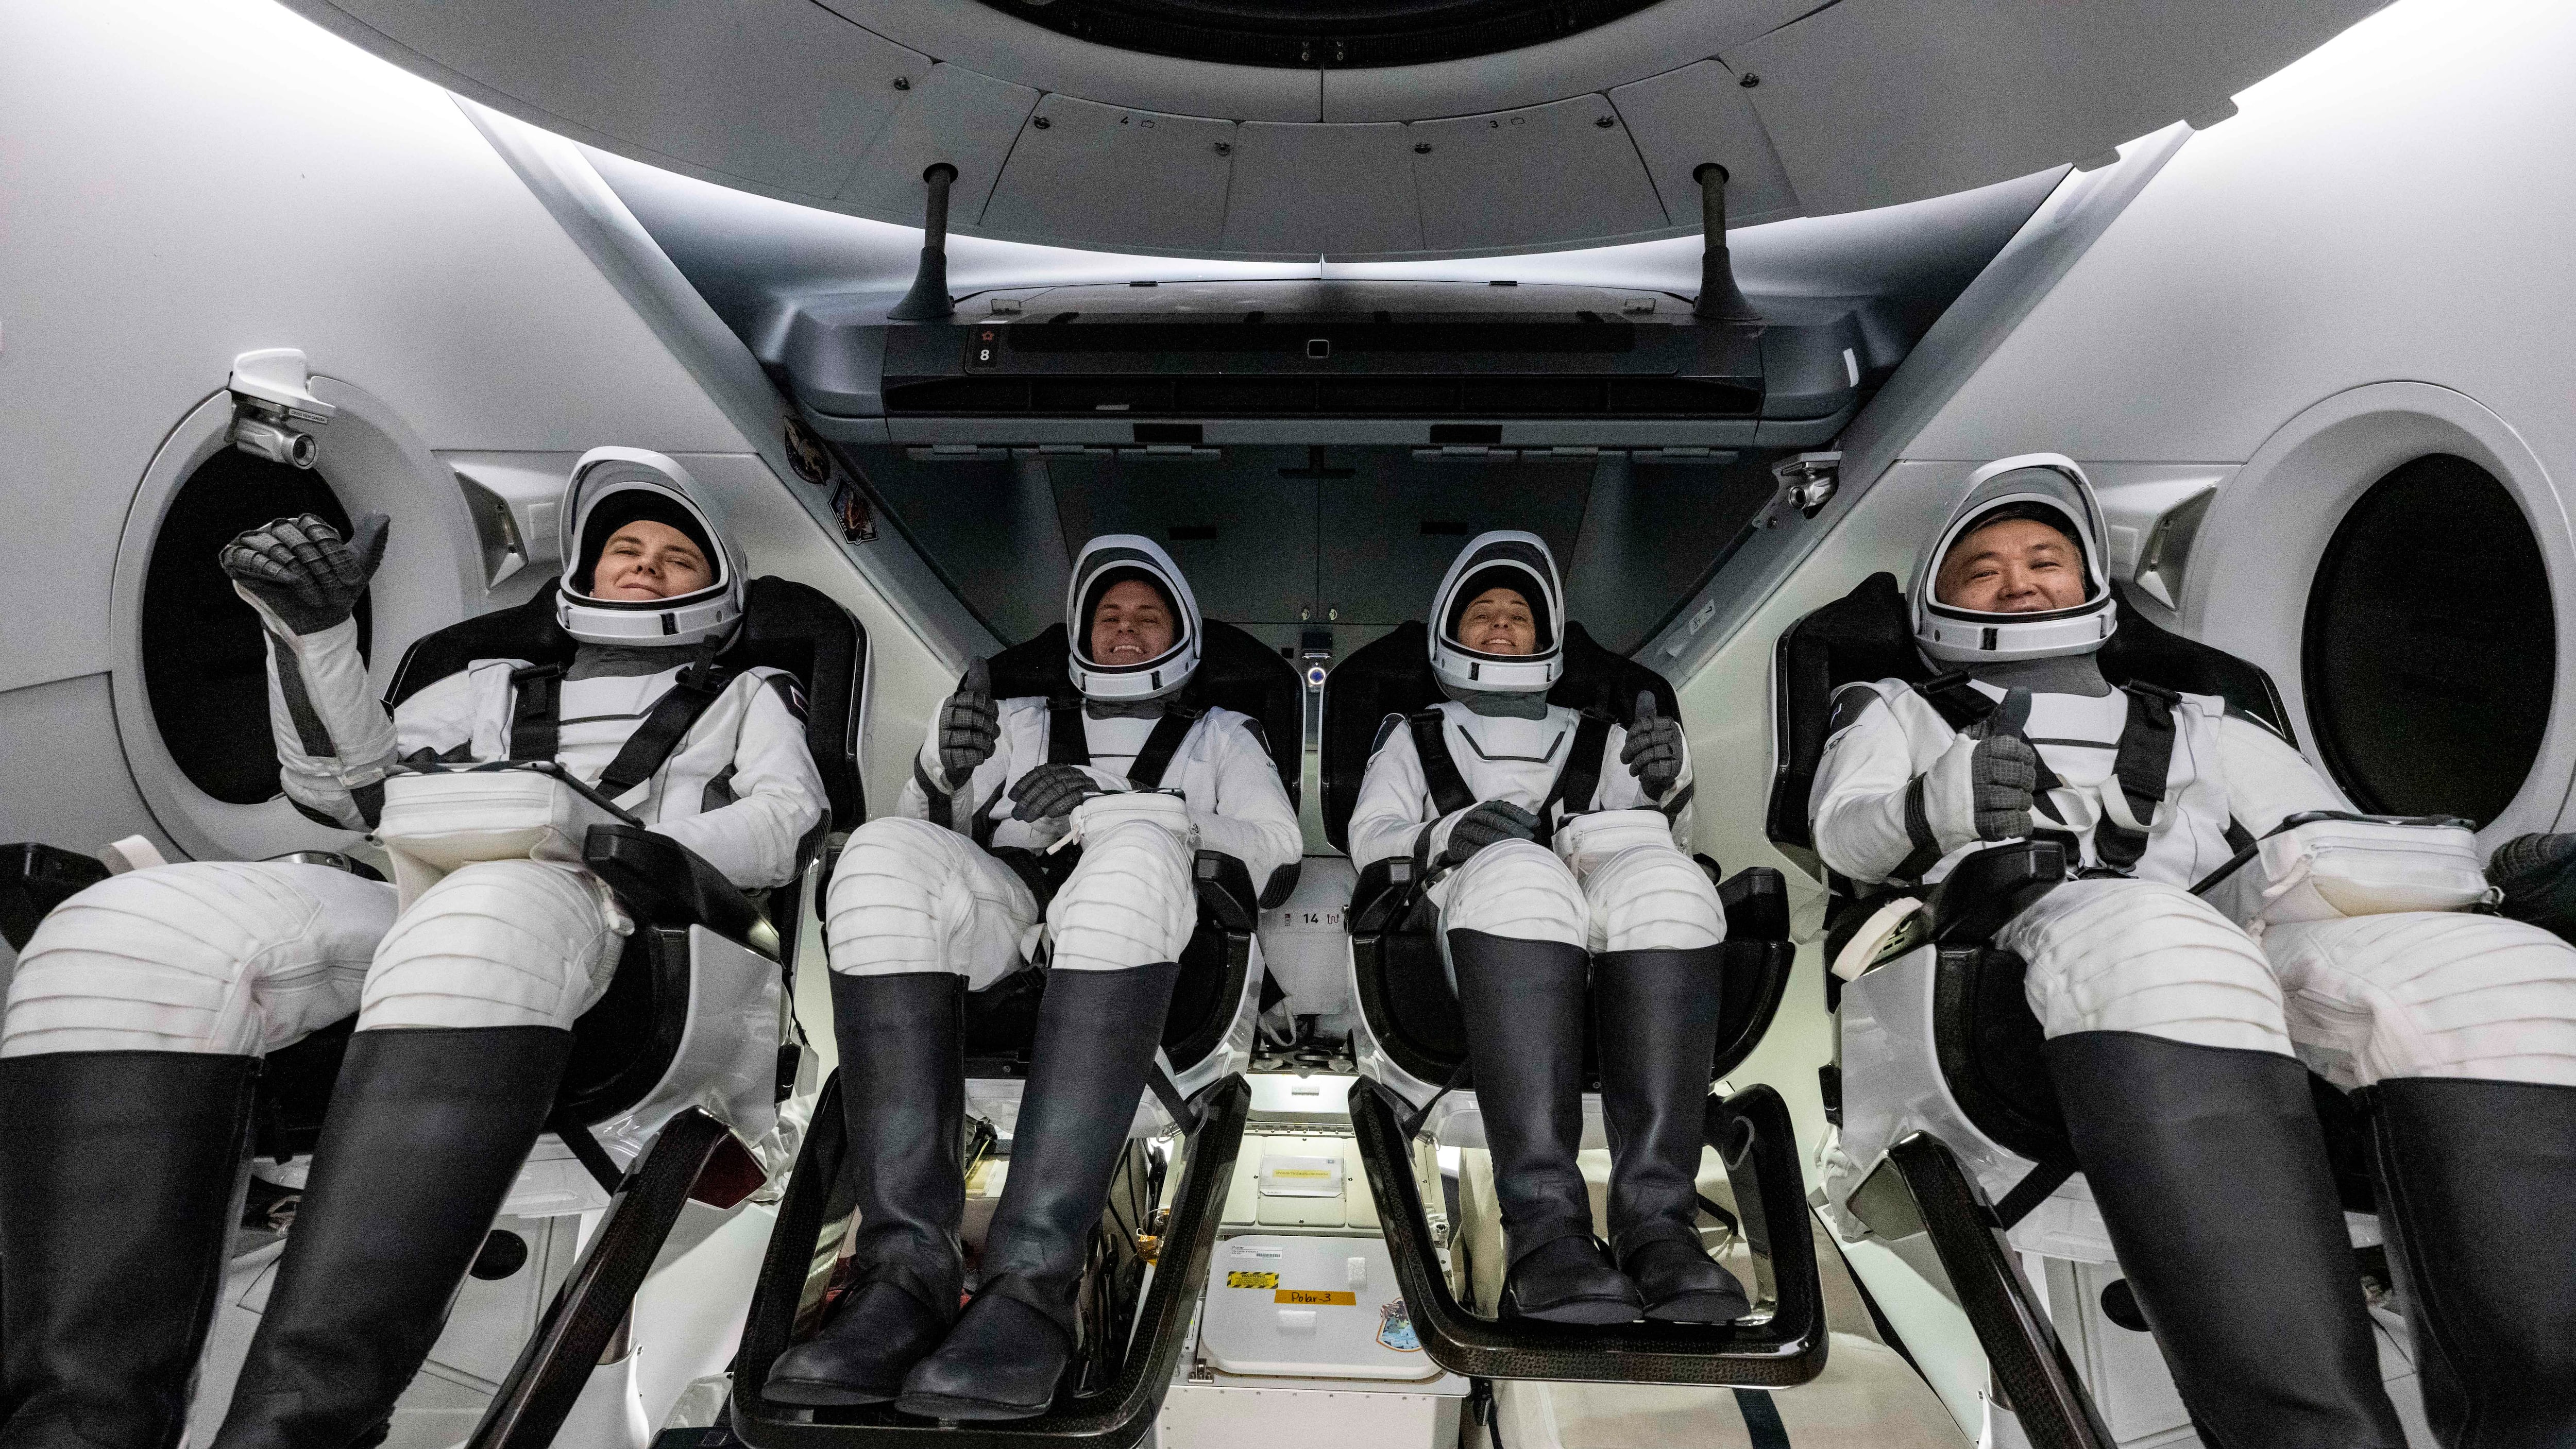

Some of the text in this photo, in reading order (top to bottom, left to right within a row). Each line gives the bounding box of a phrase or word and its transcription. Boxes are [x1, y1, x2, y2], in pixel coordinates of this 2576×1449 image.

[1120, 116, 1129, 125] 4
[1489, 120, 1499, 128] 3
[980, 349, 990, 361] 8
[1303, 913, 1318, 924] 14
[1292, 1292, 1331, 1303] Polar-3
